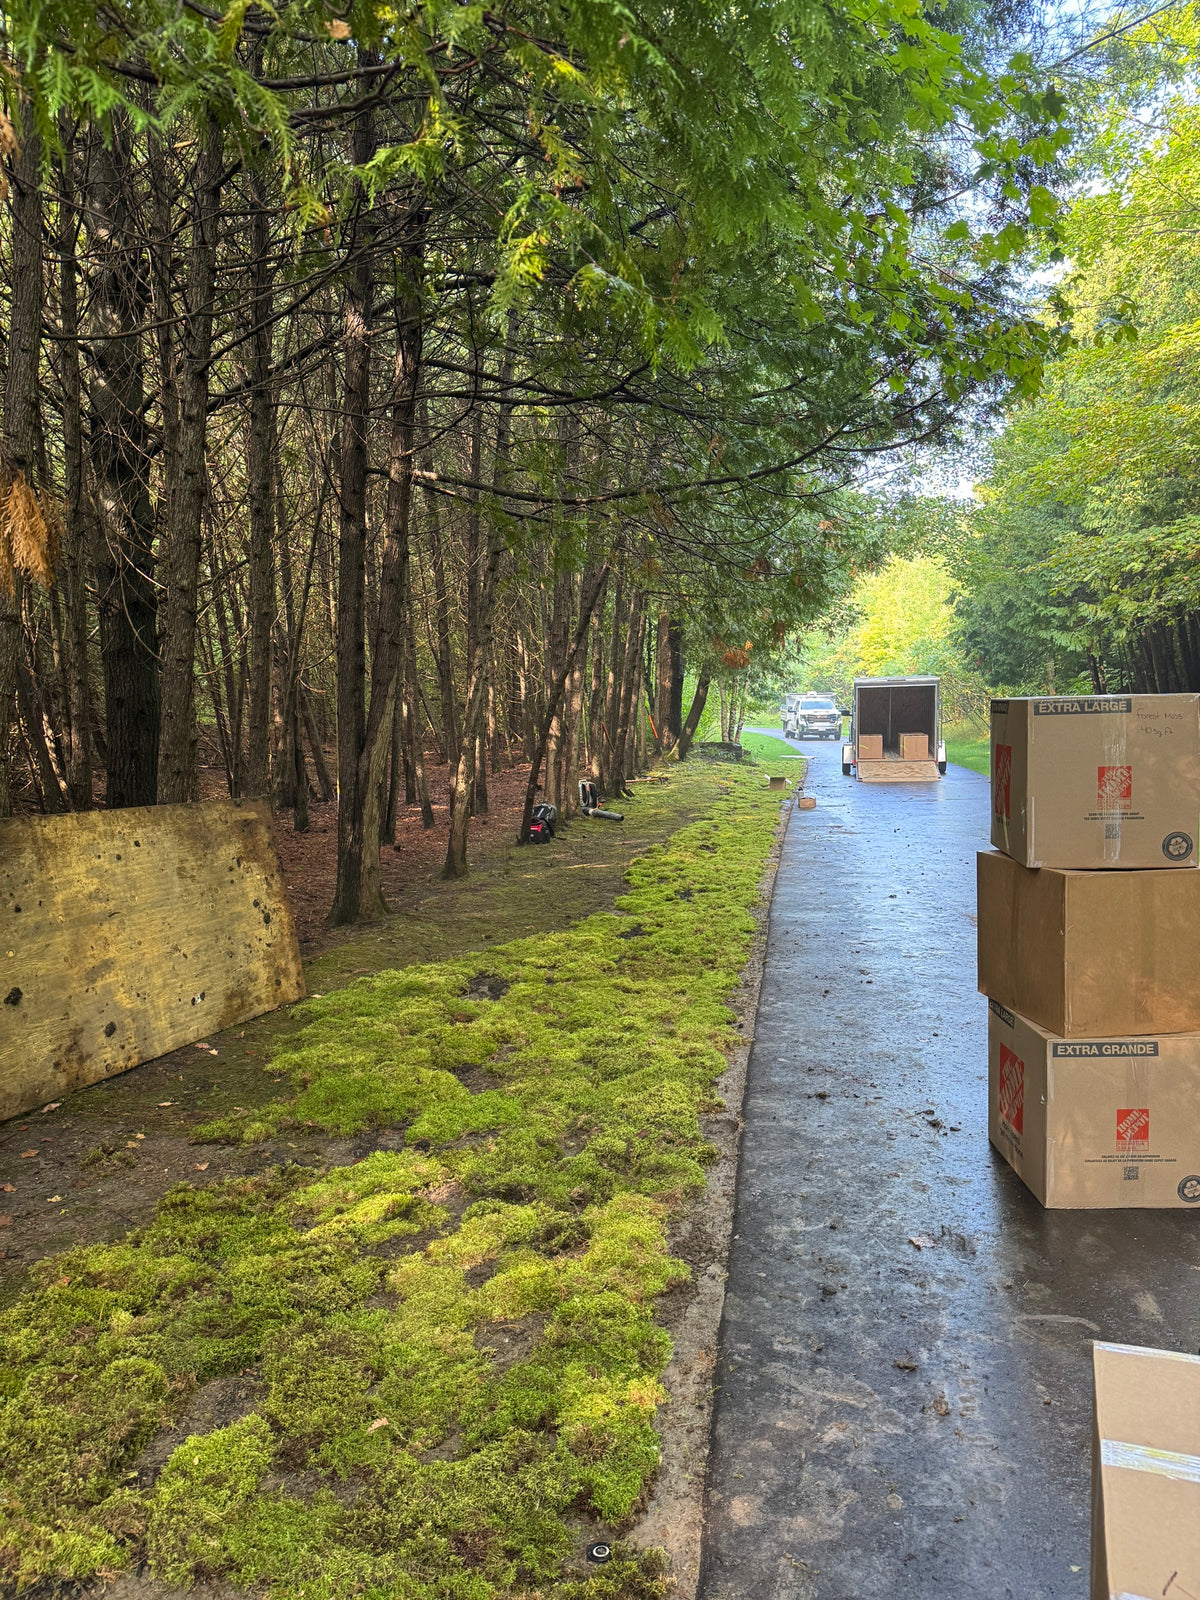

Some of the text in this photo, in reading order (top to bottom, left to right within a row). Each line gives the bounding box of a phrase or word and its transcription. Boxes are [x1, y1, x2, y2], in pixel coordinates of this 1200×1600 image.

[1039, 700, 1127, 713] EXTRA LARGE
[1057, 1044, 1155, 1055] EXTRA GRANDE
[1117, 1108, 1142, 1134] HOME
[1122, 1113, 1149, 1141] DEPOT
